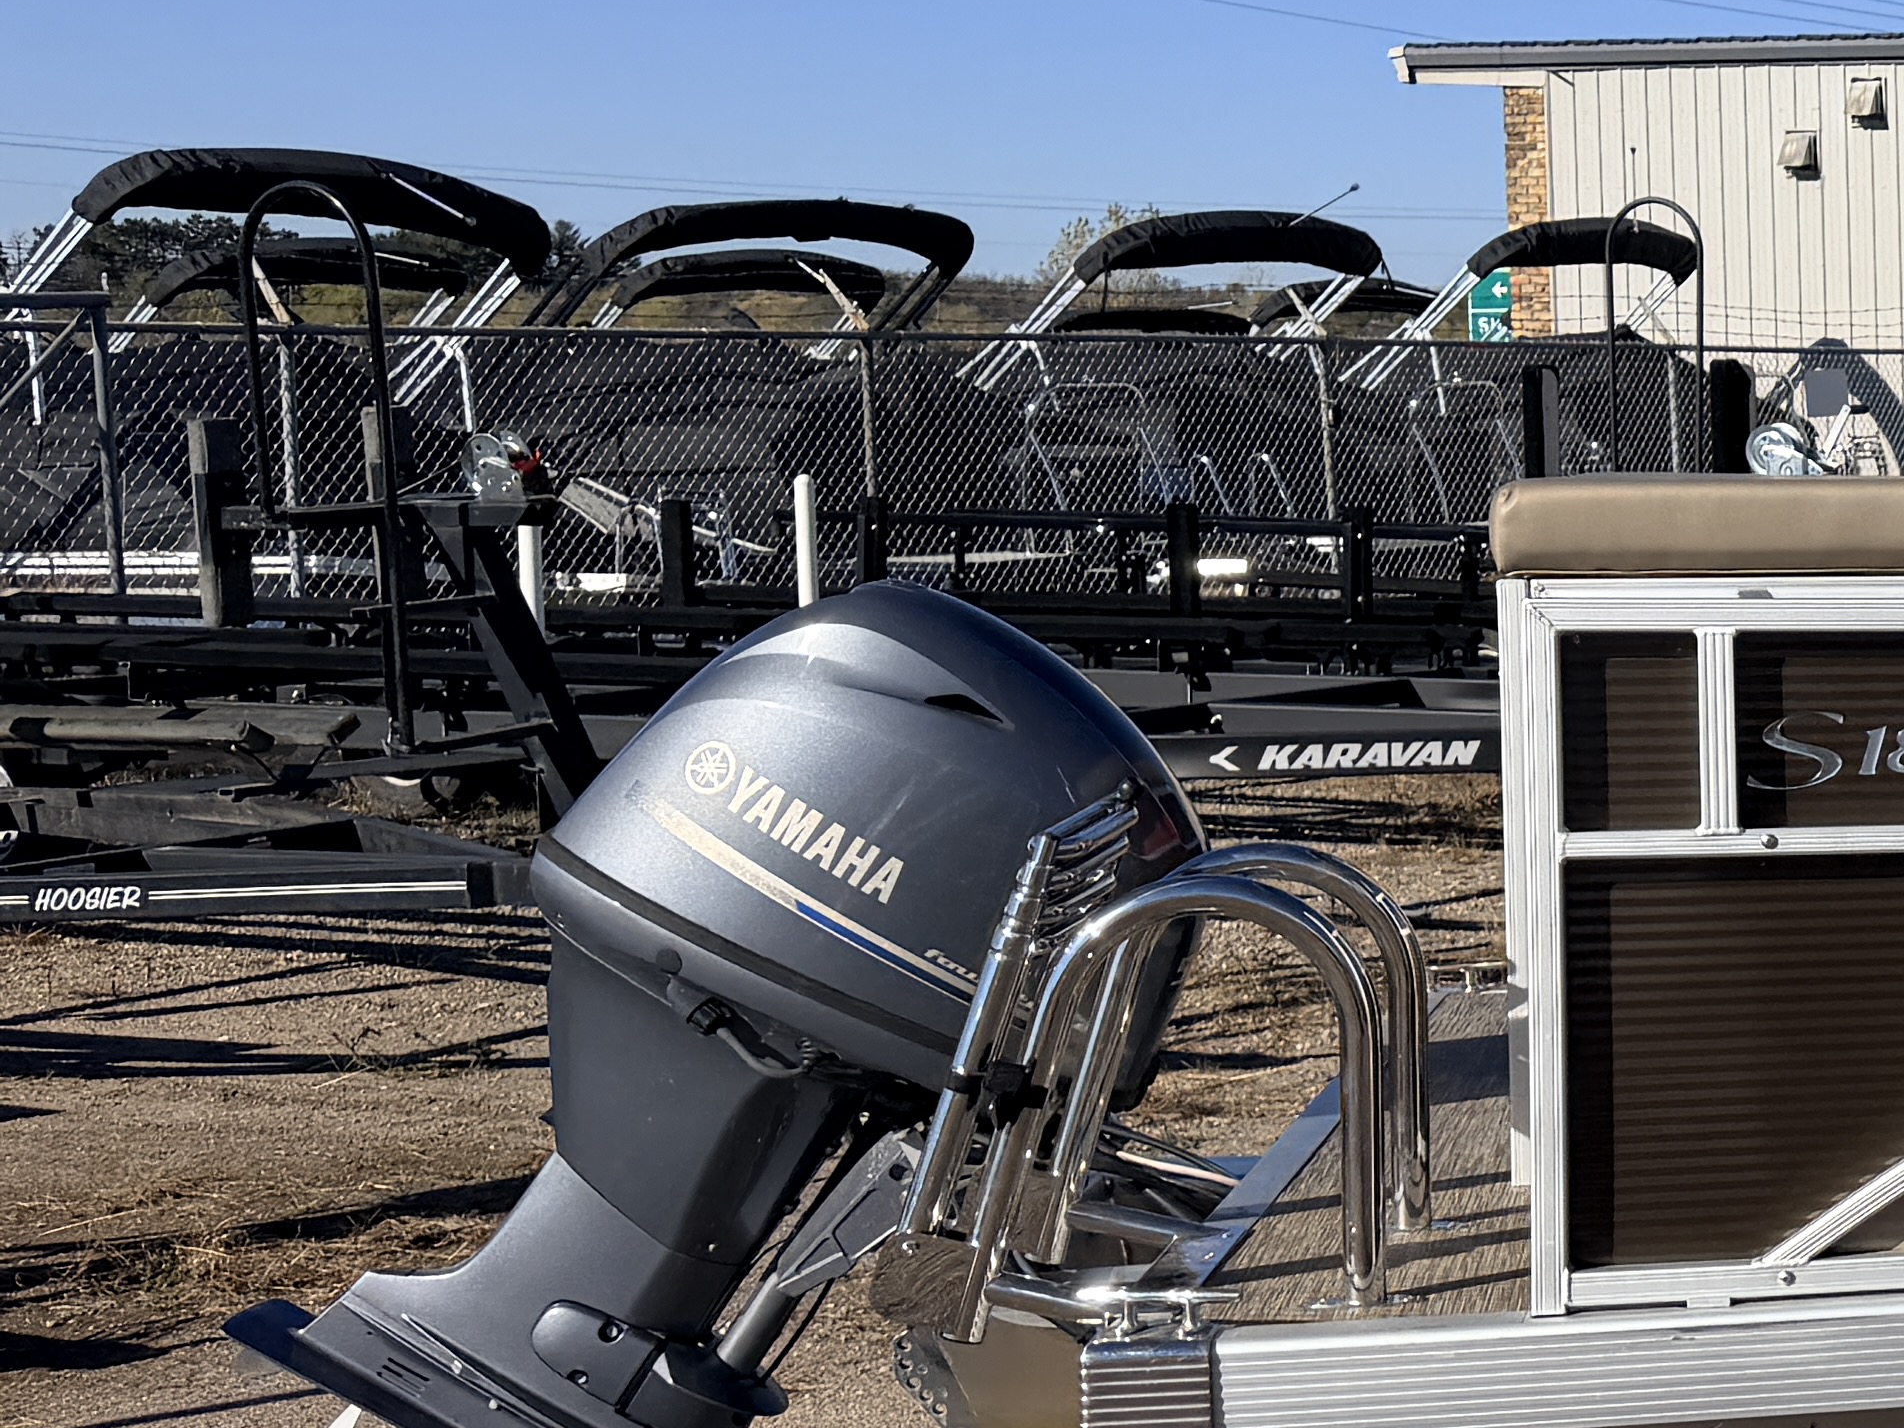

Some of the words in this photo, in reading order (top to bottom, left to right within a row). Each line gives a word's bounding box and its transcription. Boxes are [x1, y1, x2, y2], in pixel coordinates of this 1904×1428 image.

[1257, 740, 1481, 771] KARAVAN
[727, 765, 904, 904] YAMAHA
[34, 886, 141, 912] HOOSIER
[923, 948, 979, 983] fou
